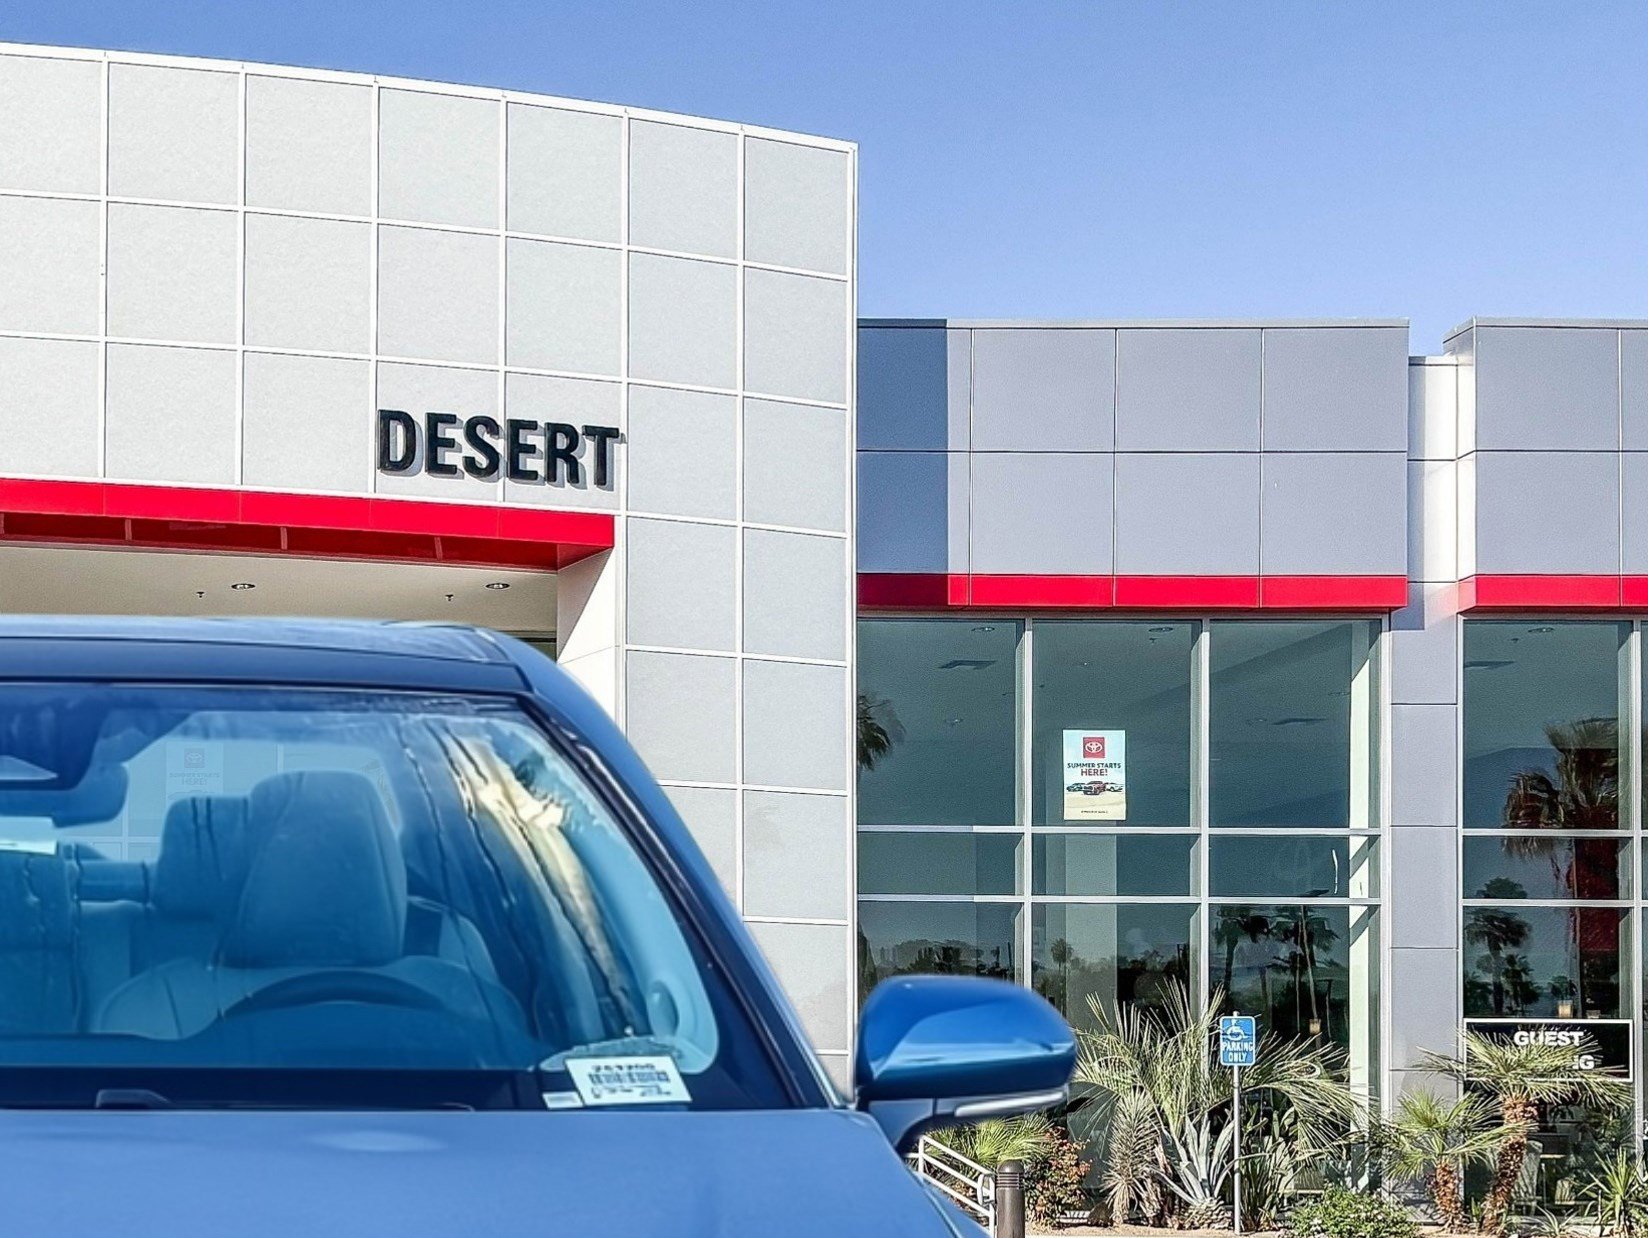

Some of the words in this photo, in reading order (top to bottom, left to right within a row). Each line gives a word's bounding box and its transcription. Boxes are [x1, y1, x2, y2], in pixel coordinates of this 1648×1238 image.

[377, 409, 620, 487] DESERT
[1081, 768, 1108, 777] HERE!
[1513, 1030, 1585, 1047] GUEST
[1222, 1041, 1253, 1051] PARKING
[1228, 1051, 1247, 1062] ONLY
